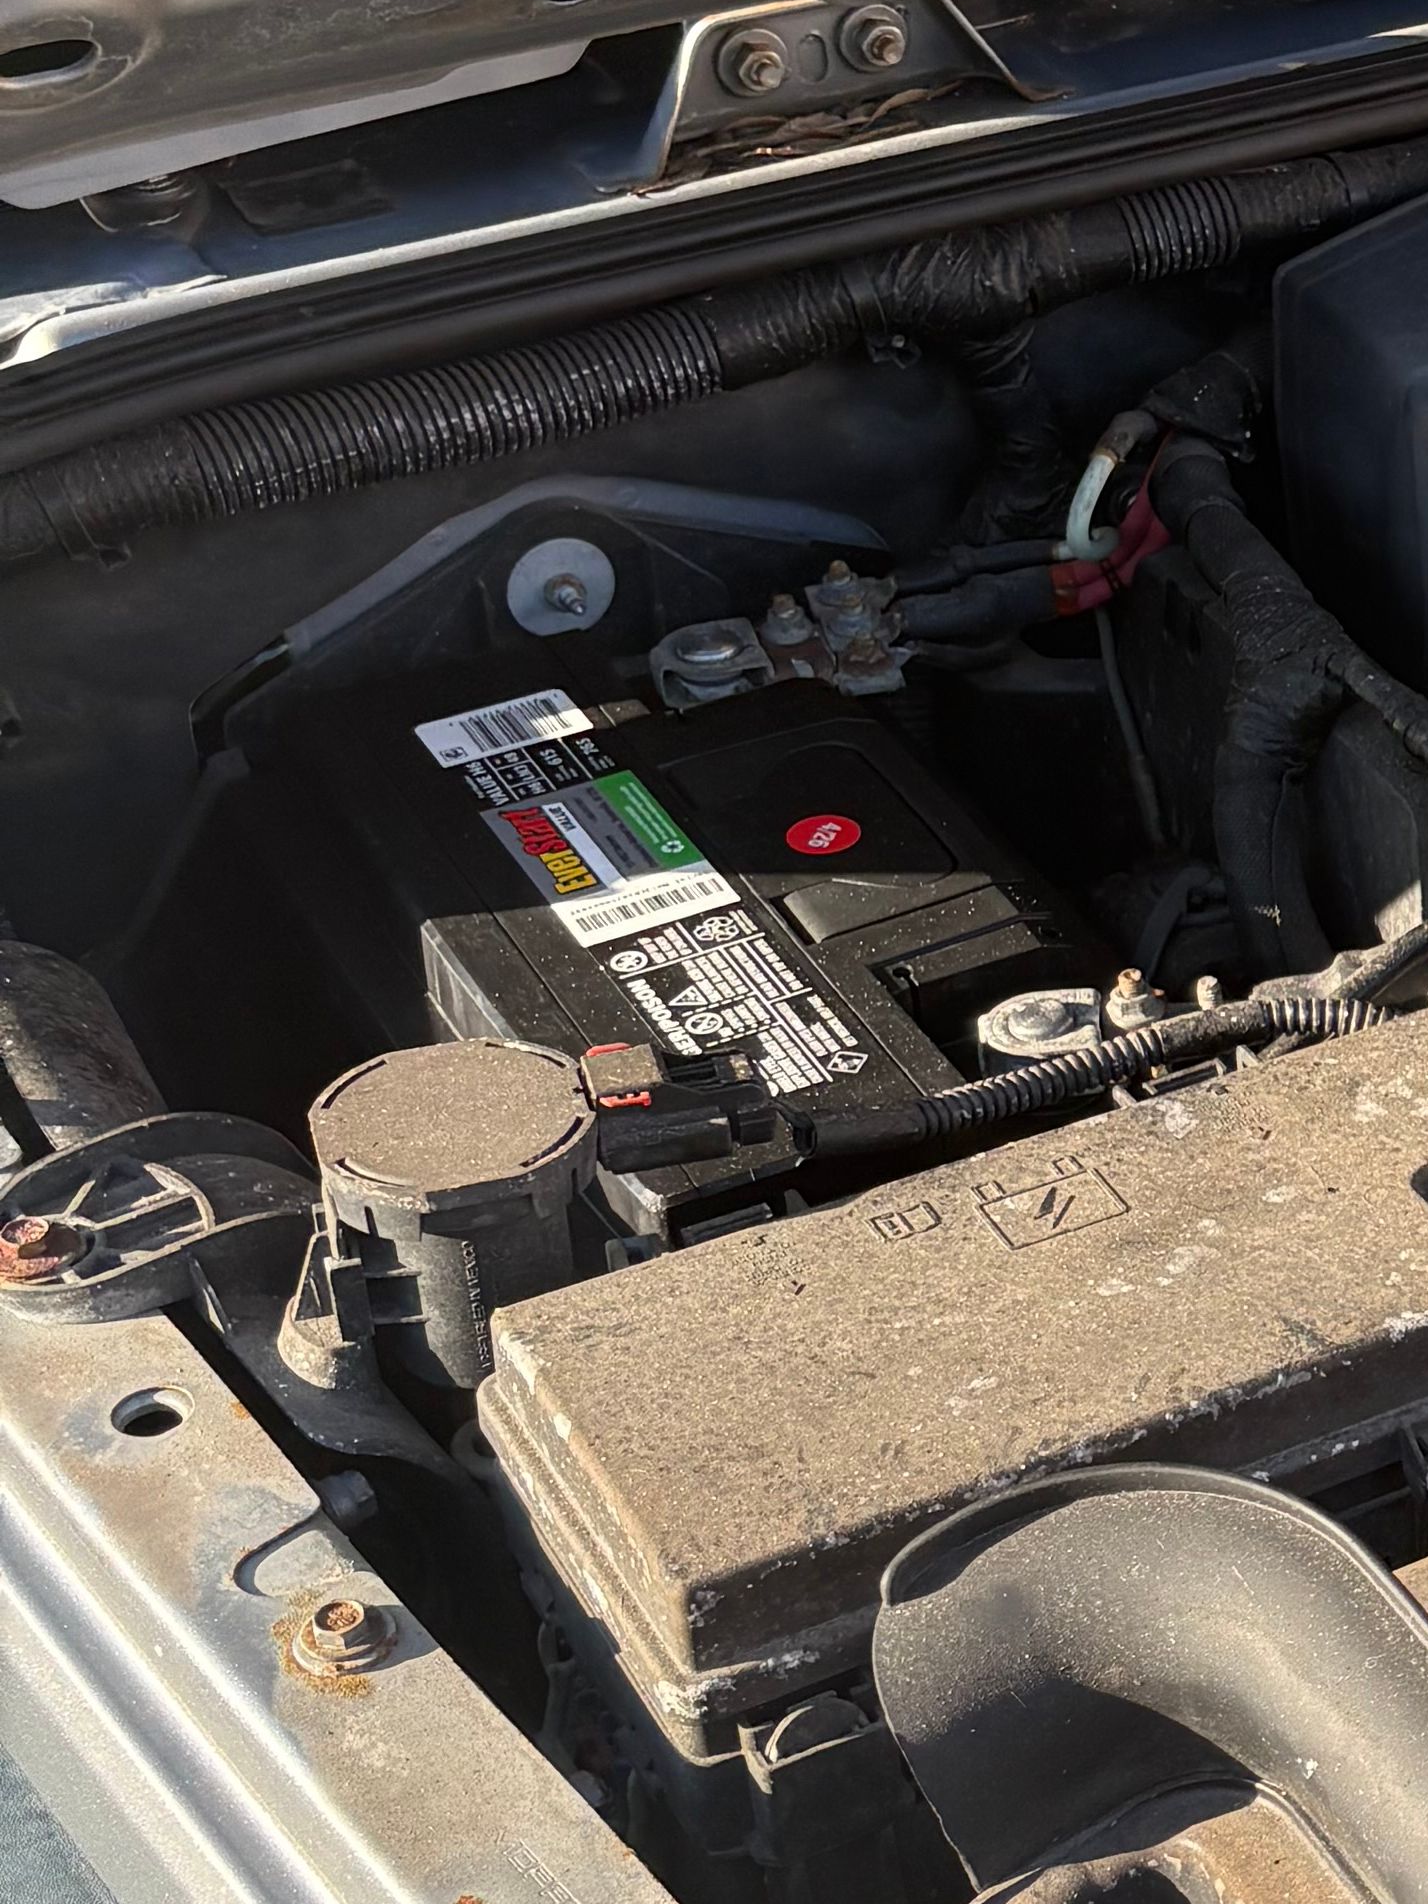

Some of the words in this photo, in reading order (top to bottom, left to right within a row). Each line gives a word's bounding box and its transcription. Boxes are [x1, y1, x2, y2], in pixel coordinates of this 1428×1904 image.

[537, 747, 564, 766] 615
[474, 773, 511, 805] VALUE
[548, 805, 577, 828] VALUE
[500, 805, 599, 895] EverStart
[807, 820, 844, 850] 4/26
[626, 978, 704, 1056] GER/POISON
